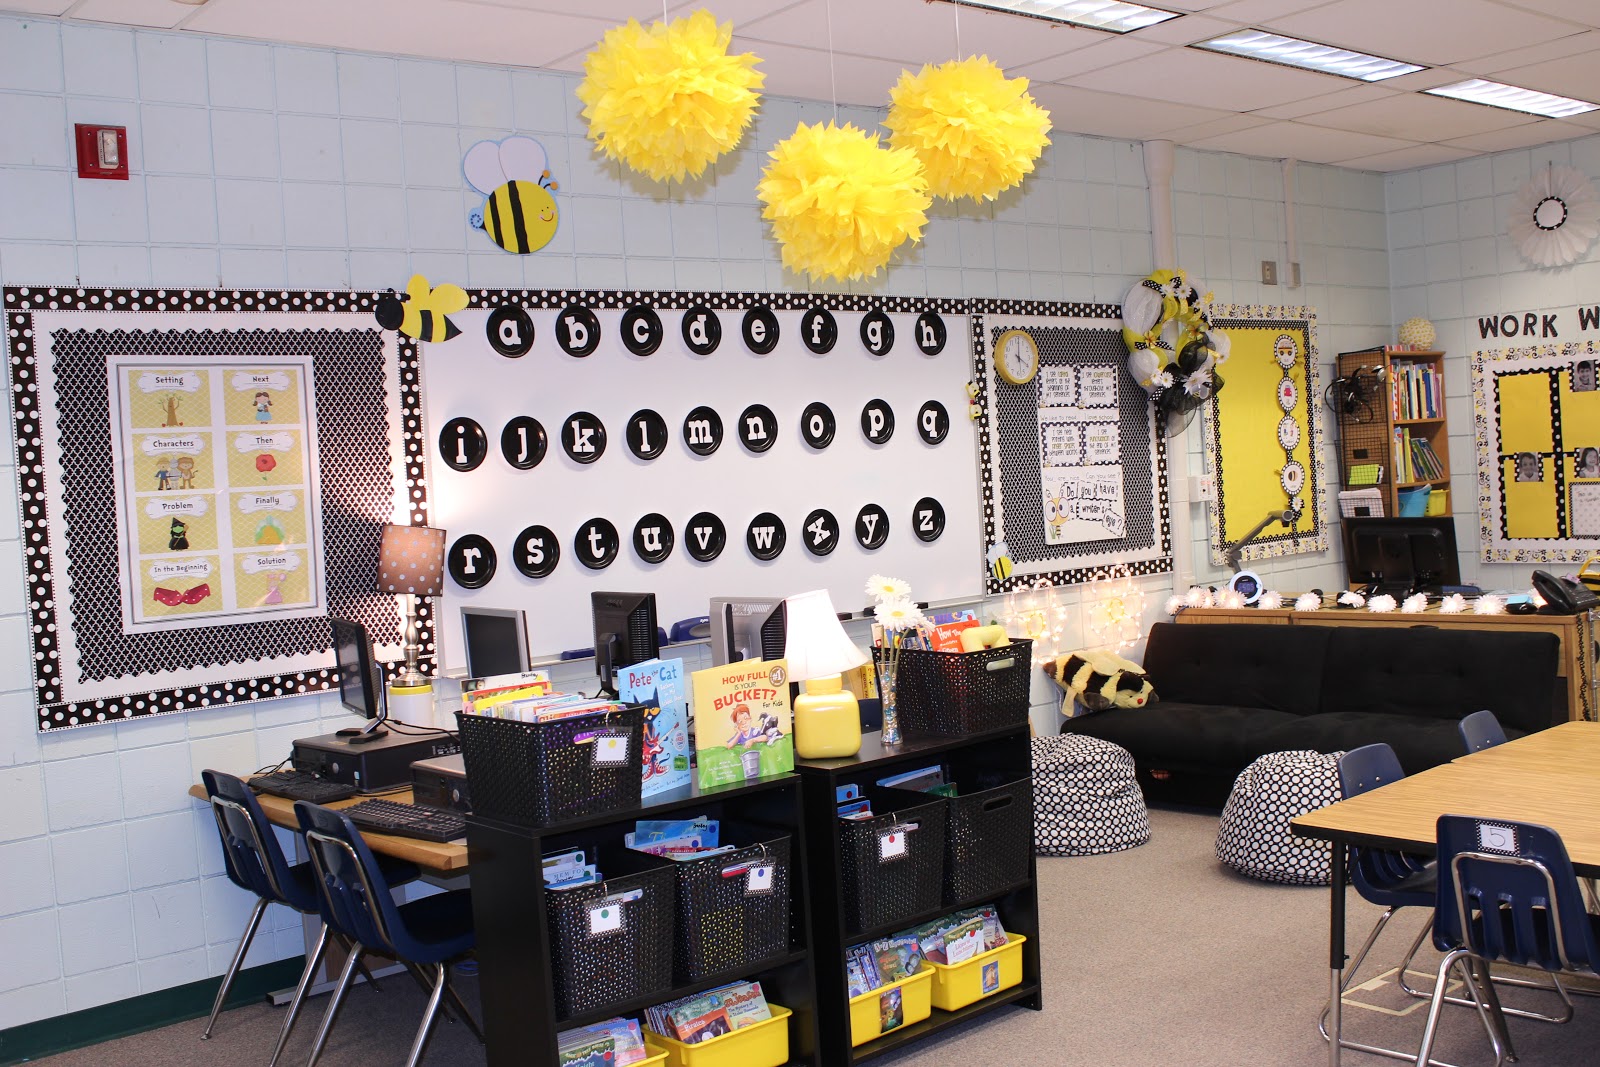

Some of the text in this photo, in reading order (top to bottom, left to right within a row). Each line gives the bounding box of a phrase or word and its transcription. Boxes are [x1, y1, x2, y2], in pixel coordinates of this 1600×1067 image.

[1478, 313, 1559, 339] WORK
[499, 315, 936, 350] a b c d e f g h
[155, 376, 184, 386] Setting
[253, 375, 269, 383] Next
[255, 437, 274, 445] Then
[456, 426, 467, 463] i
[571, 421, 595, 452] k
[640, 421, 650, 451] l
[689, 420, 713, 444] m
[747, 417, 766, 440] n
[810, 415, 823, 438] o
[869, 408, 884, 437] p
[923, 410, 939, 438] q
[153, 439, 194, 448] Characters
[162, 502, 194, 510] Problem
[255, 496, 280, 506] Finally
[464, 510, 933, 574] r s t u v w x y z
[257, 557, 287, 566] Solution
[176, 563, 208, 573] Beginning
[629, 672, 651, 689] Pete
[660, 665, 677, 681] Cat
[722, 671, 768, 685] HOW FULL
[713, 689, 777, 711] BUCKET?
[1489, 828, 1507, 847] 5
[684, 1020, 706, 1032] Pirates
